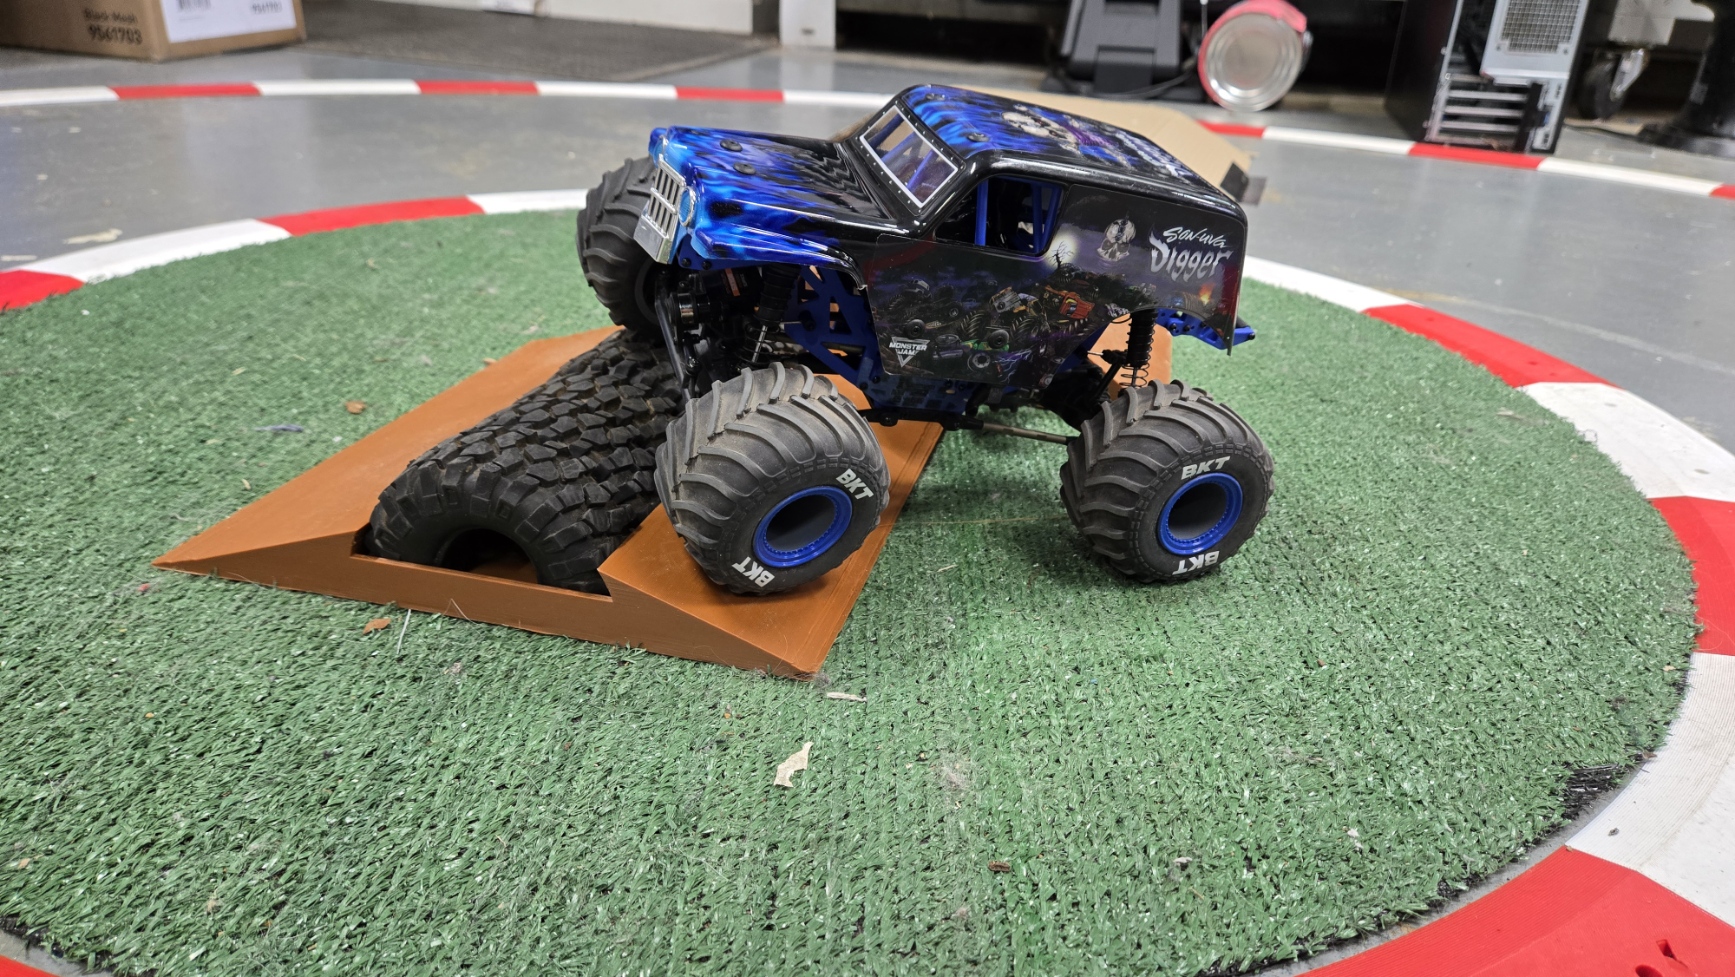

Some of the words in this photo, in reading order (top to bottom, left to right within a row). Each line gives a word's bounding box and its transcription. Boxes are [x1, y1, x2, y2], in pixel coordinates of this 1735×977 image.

[88, 24, 143, 45] 9561703
[1149, 230, 1234, 282] Digger
[889, 342, 928, 351] MONSTER
[1181, 456, 1231, 480] BKT
[835, 468, 874, 500] BKT
[731, 556, 775, 588] BKT
[1172, 550, 1220, 575] BKT
